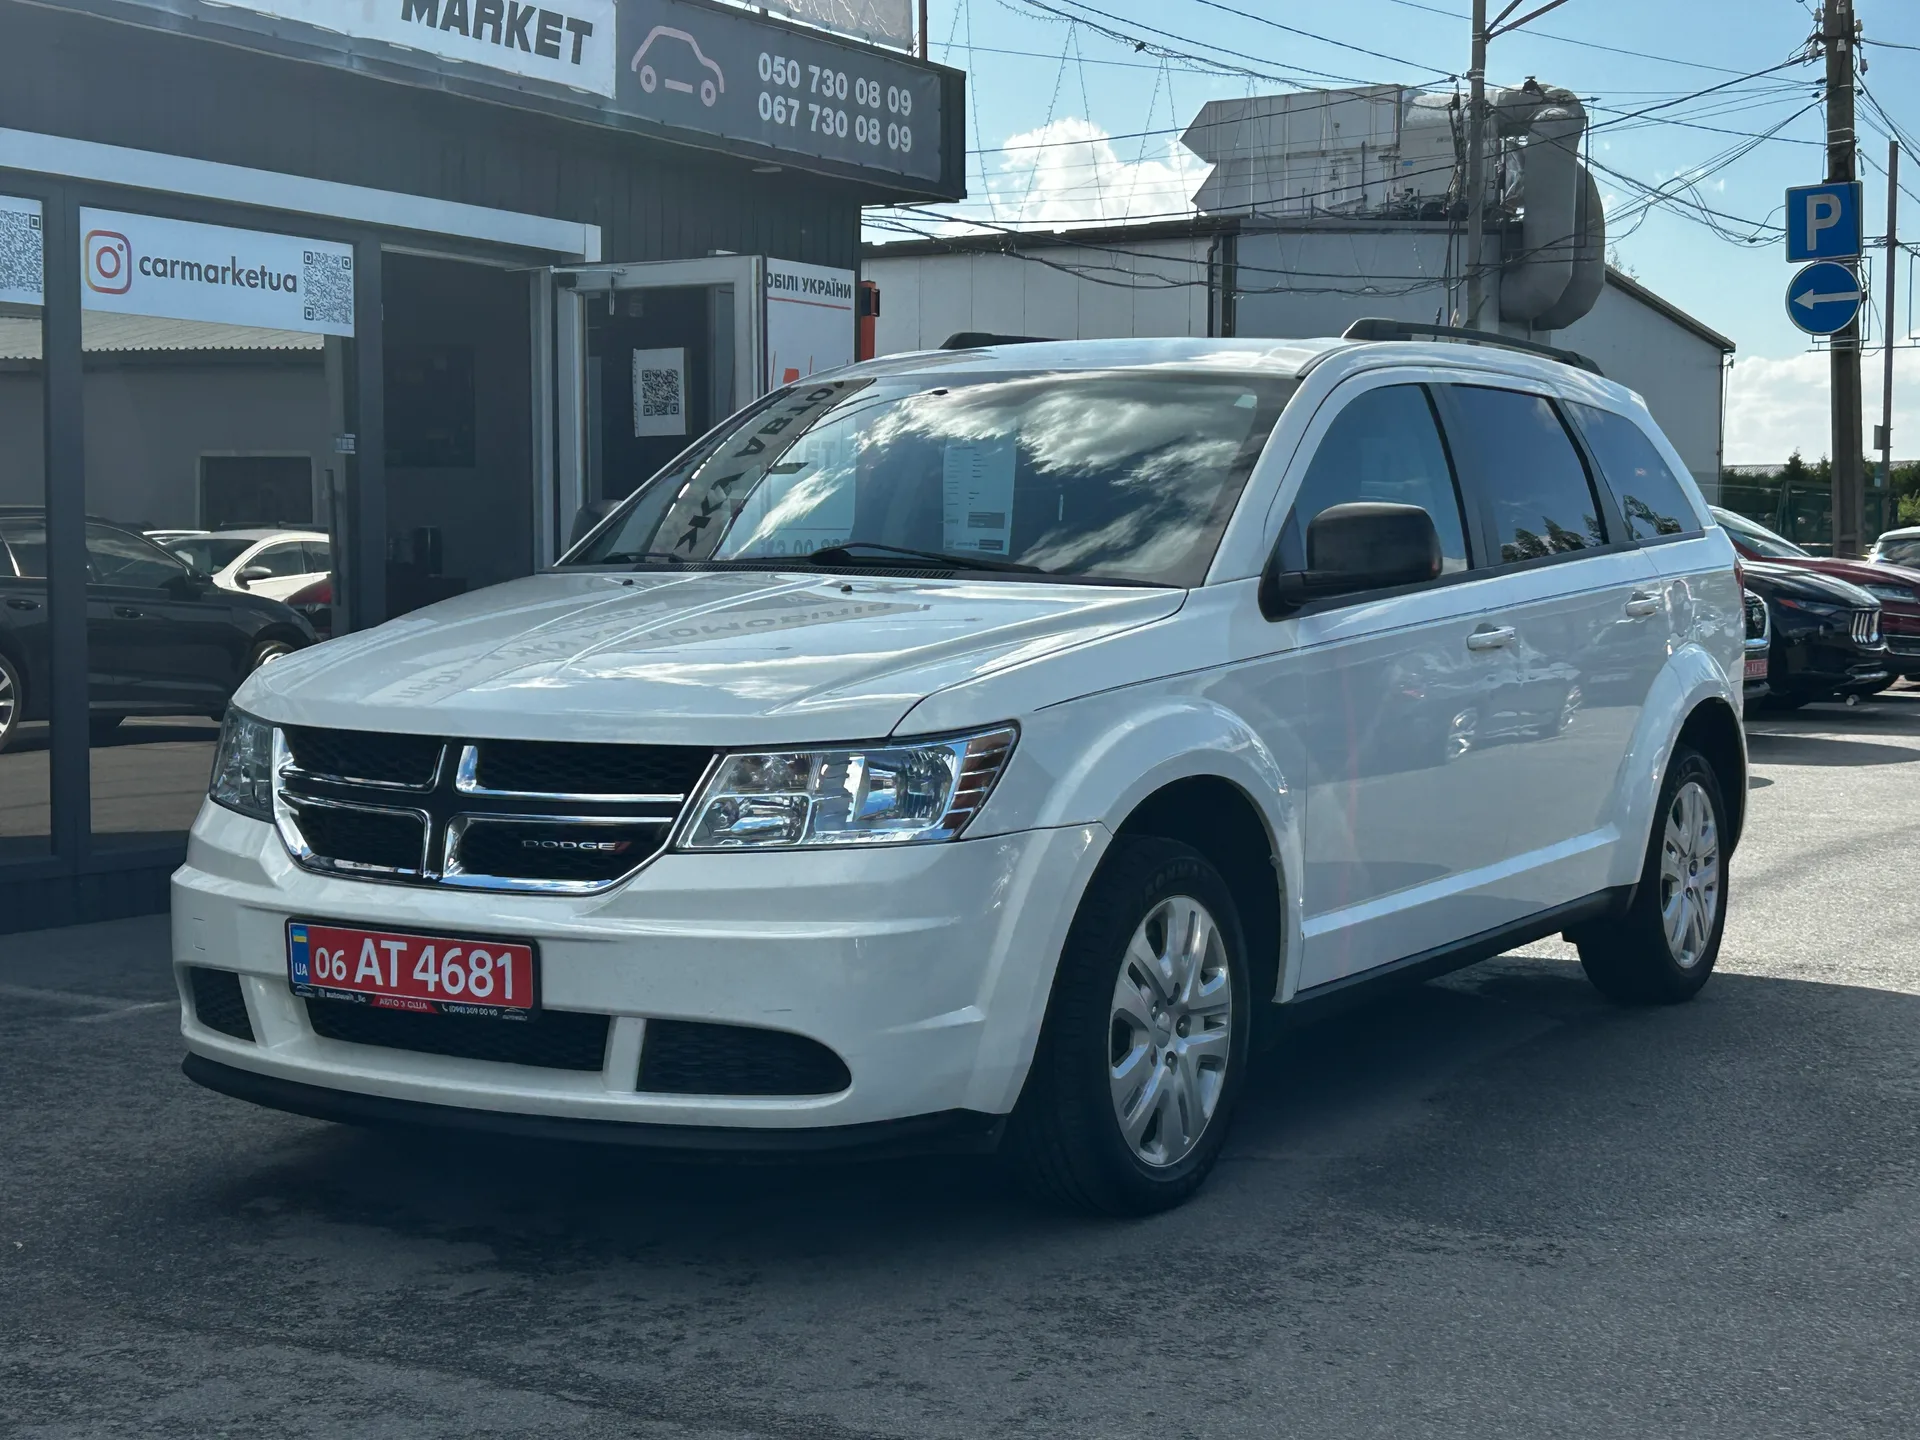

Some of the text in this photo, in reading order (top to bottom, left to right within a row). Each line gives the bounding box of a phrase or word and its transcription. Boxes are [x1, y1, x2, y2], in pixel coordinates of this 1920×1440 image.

[401, 0, 593, 65] MARKET
[758, 52, 912, 117] 050 730 08 09
[758, 91, 912, 153] 067 730 08 09
[1806, 193, 1842, 251] P
[139, 253, 298, 294] carmarketua
[802, 275, 852, 299] УКРАЇНИ
[522, 839, 616, 851] DODGE
[294, 962, 308, 977] UA
[315, 938, 513, 1000] 06 AT 4681
